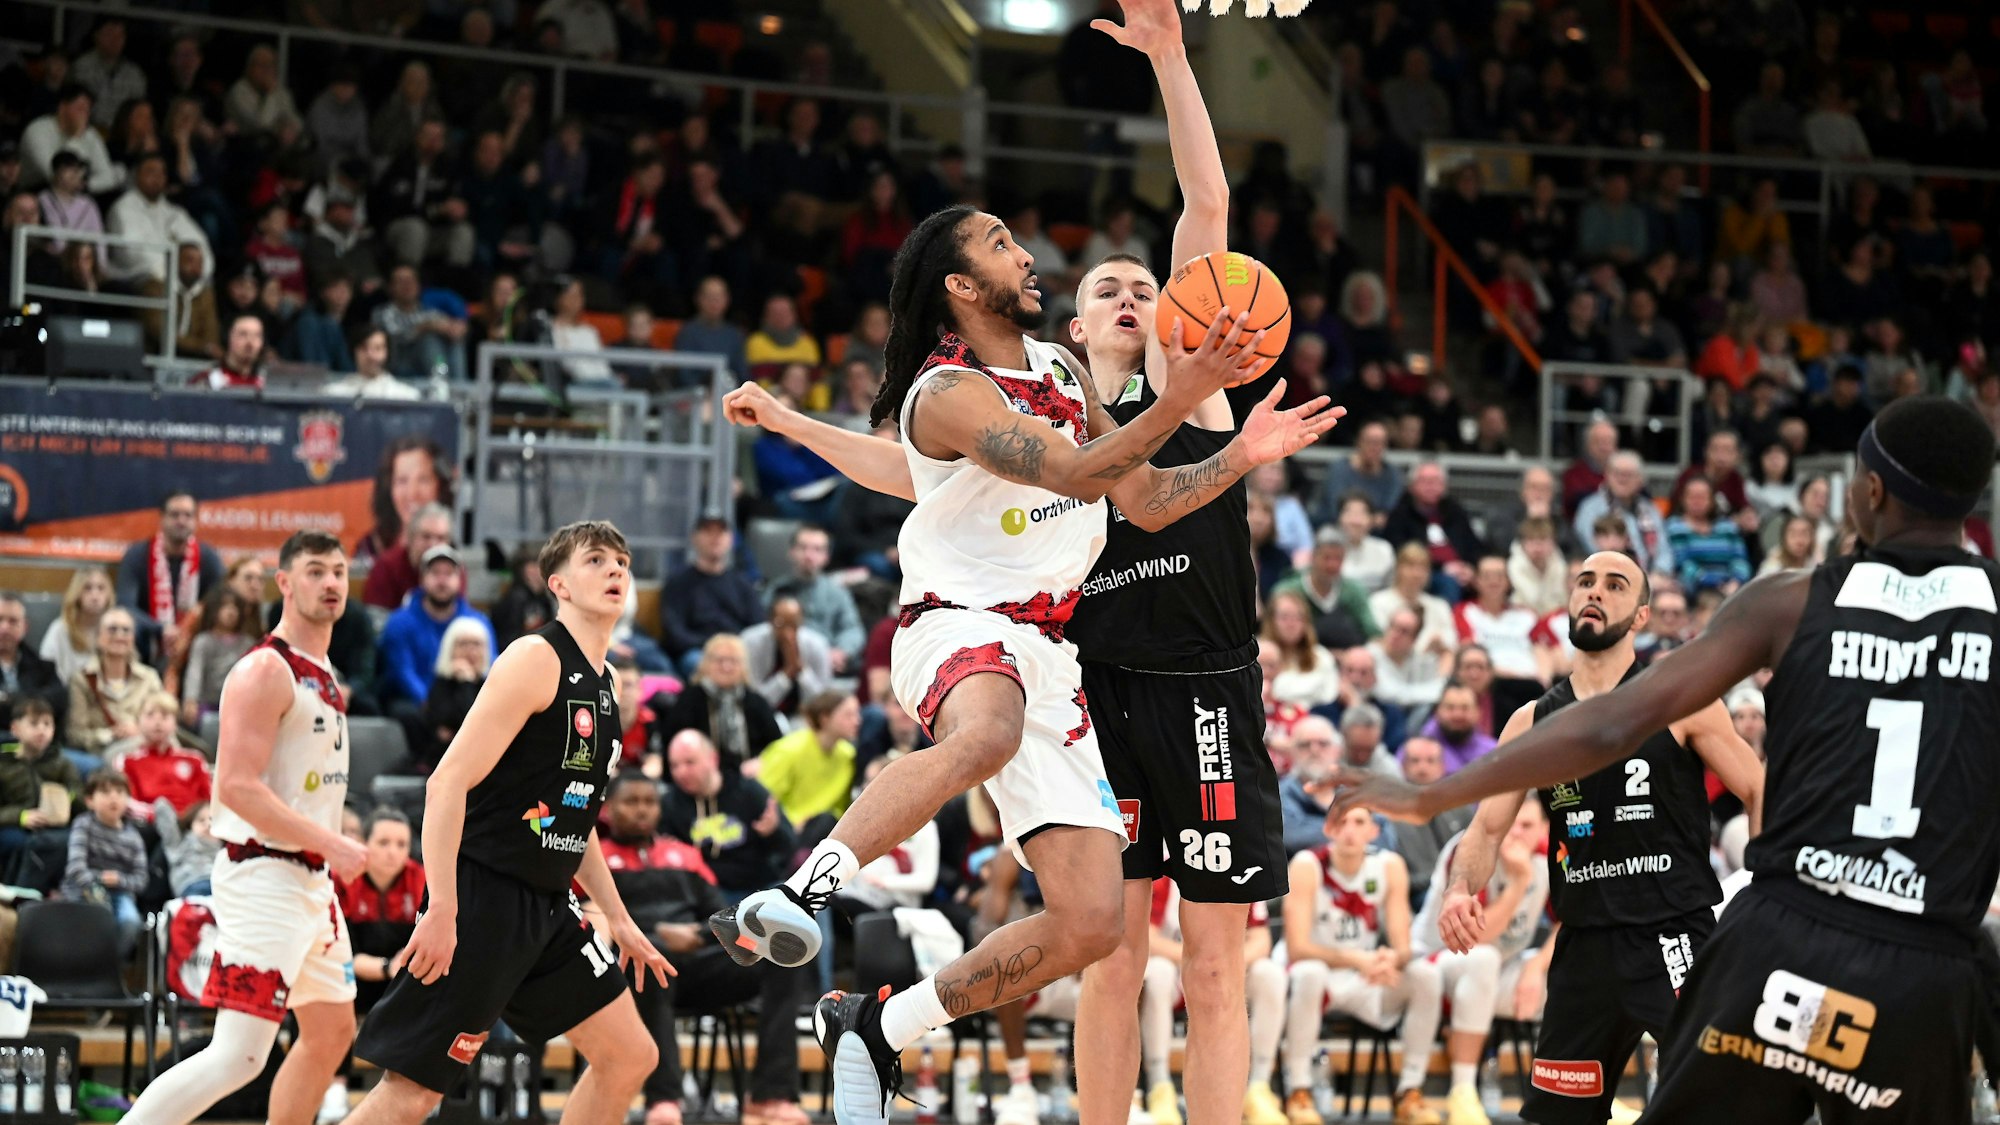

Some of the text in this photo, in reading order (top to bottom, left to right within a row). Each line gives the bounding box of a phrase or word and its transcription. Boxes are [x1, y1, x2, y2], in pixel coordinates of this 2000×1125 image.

[1082, 554, 1190, 597] estfalenWIND
[1882, 573, 1952, 603] HESSE
[1828, 630, 1993, 684] HUNT JR
[1217, 706, 1234, 780] NUTRITION
[565, 780, 595, 797] JUMP
[1624, 758, 1651, 797] 2
[1852, 697, 1924, 839] 1
[1179, 828, 1232, 873] 26
[1795, 845, 1927, 900] FOXWATCH
[1534, 1064, 1597, 1083] ROAD HOUSE
